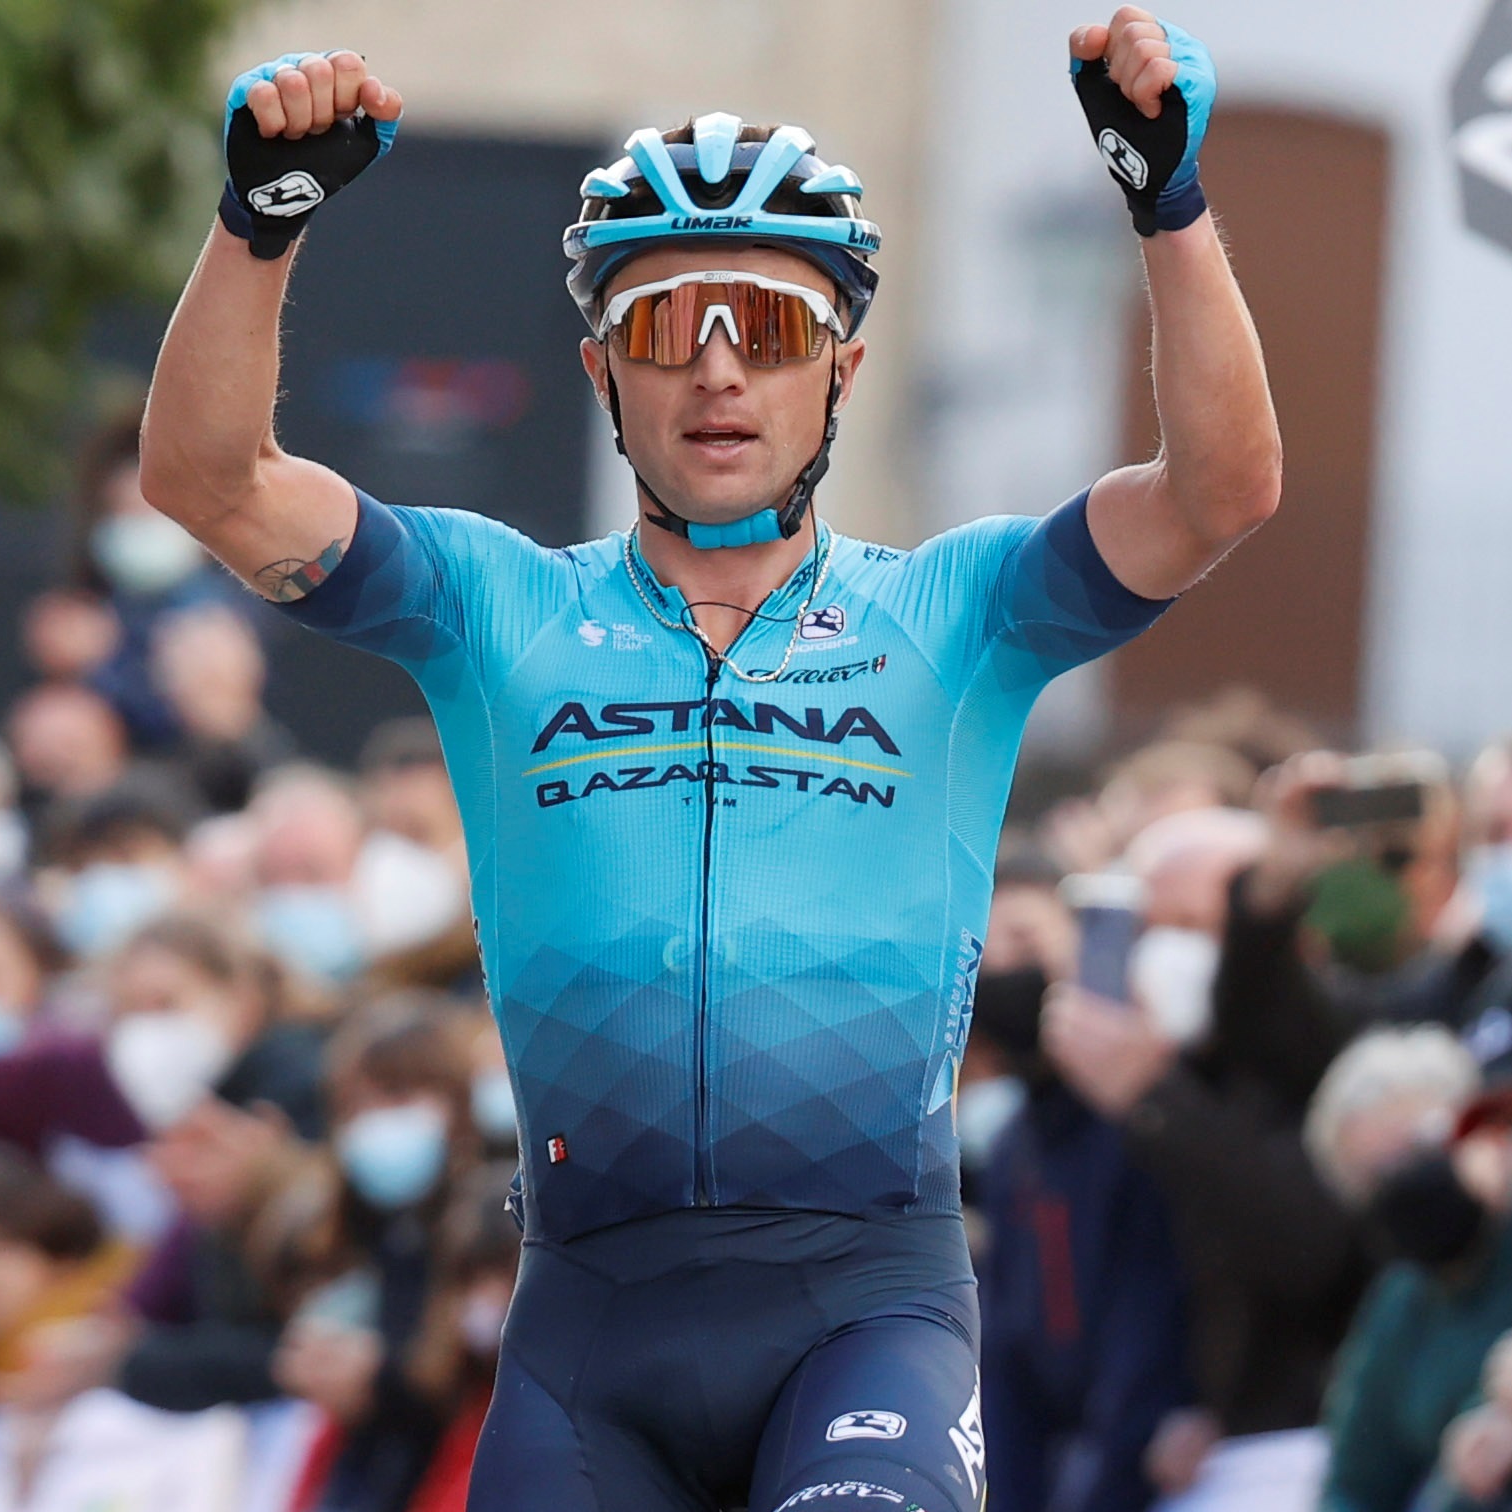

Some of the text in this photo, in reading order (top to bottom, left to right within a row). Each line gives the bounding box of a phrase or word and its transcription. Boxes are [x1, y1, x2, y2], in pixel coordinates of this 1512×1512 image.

[612, 623, 635, 633] UCI
[612, 632, 653, 643] WORLD
[612, 641, 643, 650] TEAM
[530, 698, 902, 757] ASTANA
[536, 761, 896, 808] QAZAQSTAN
